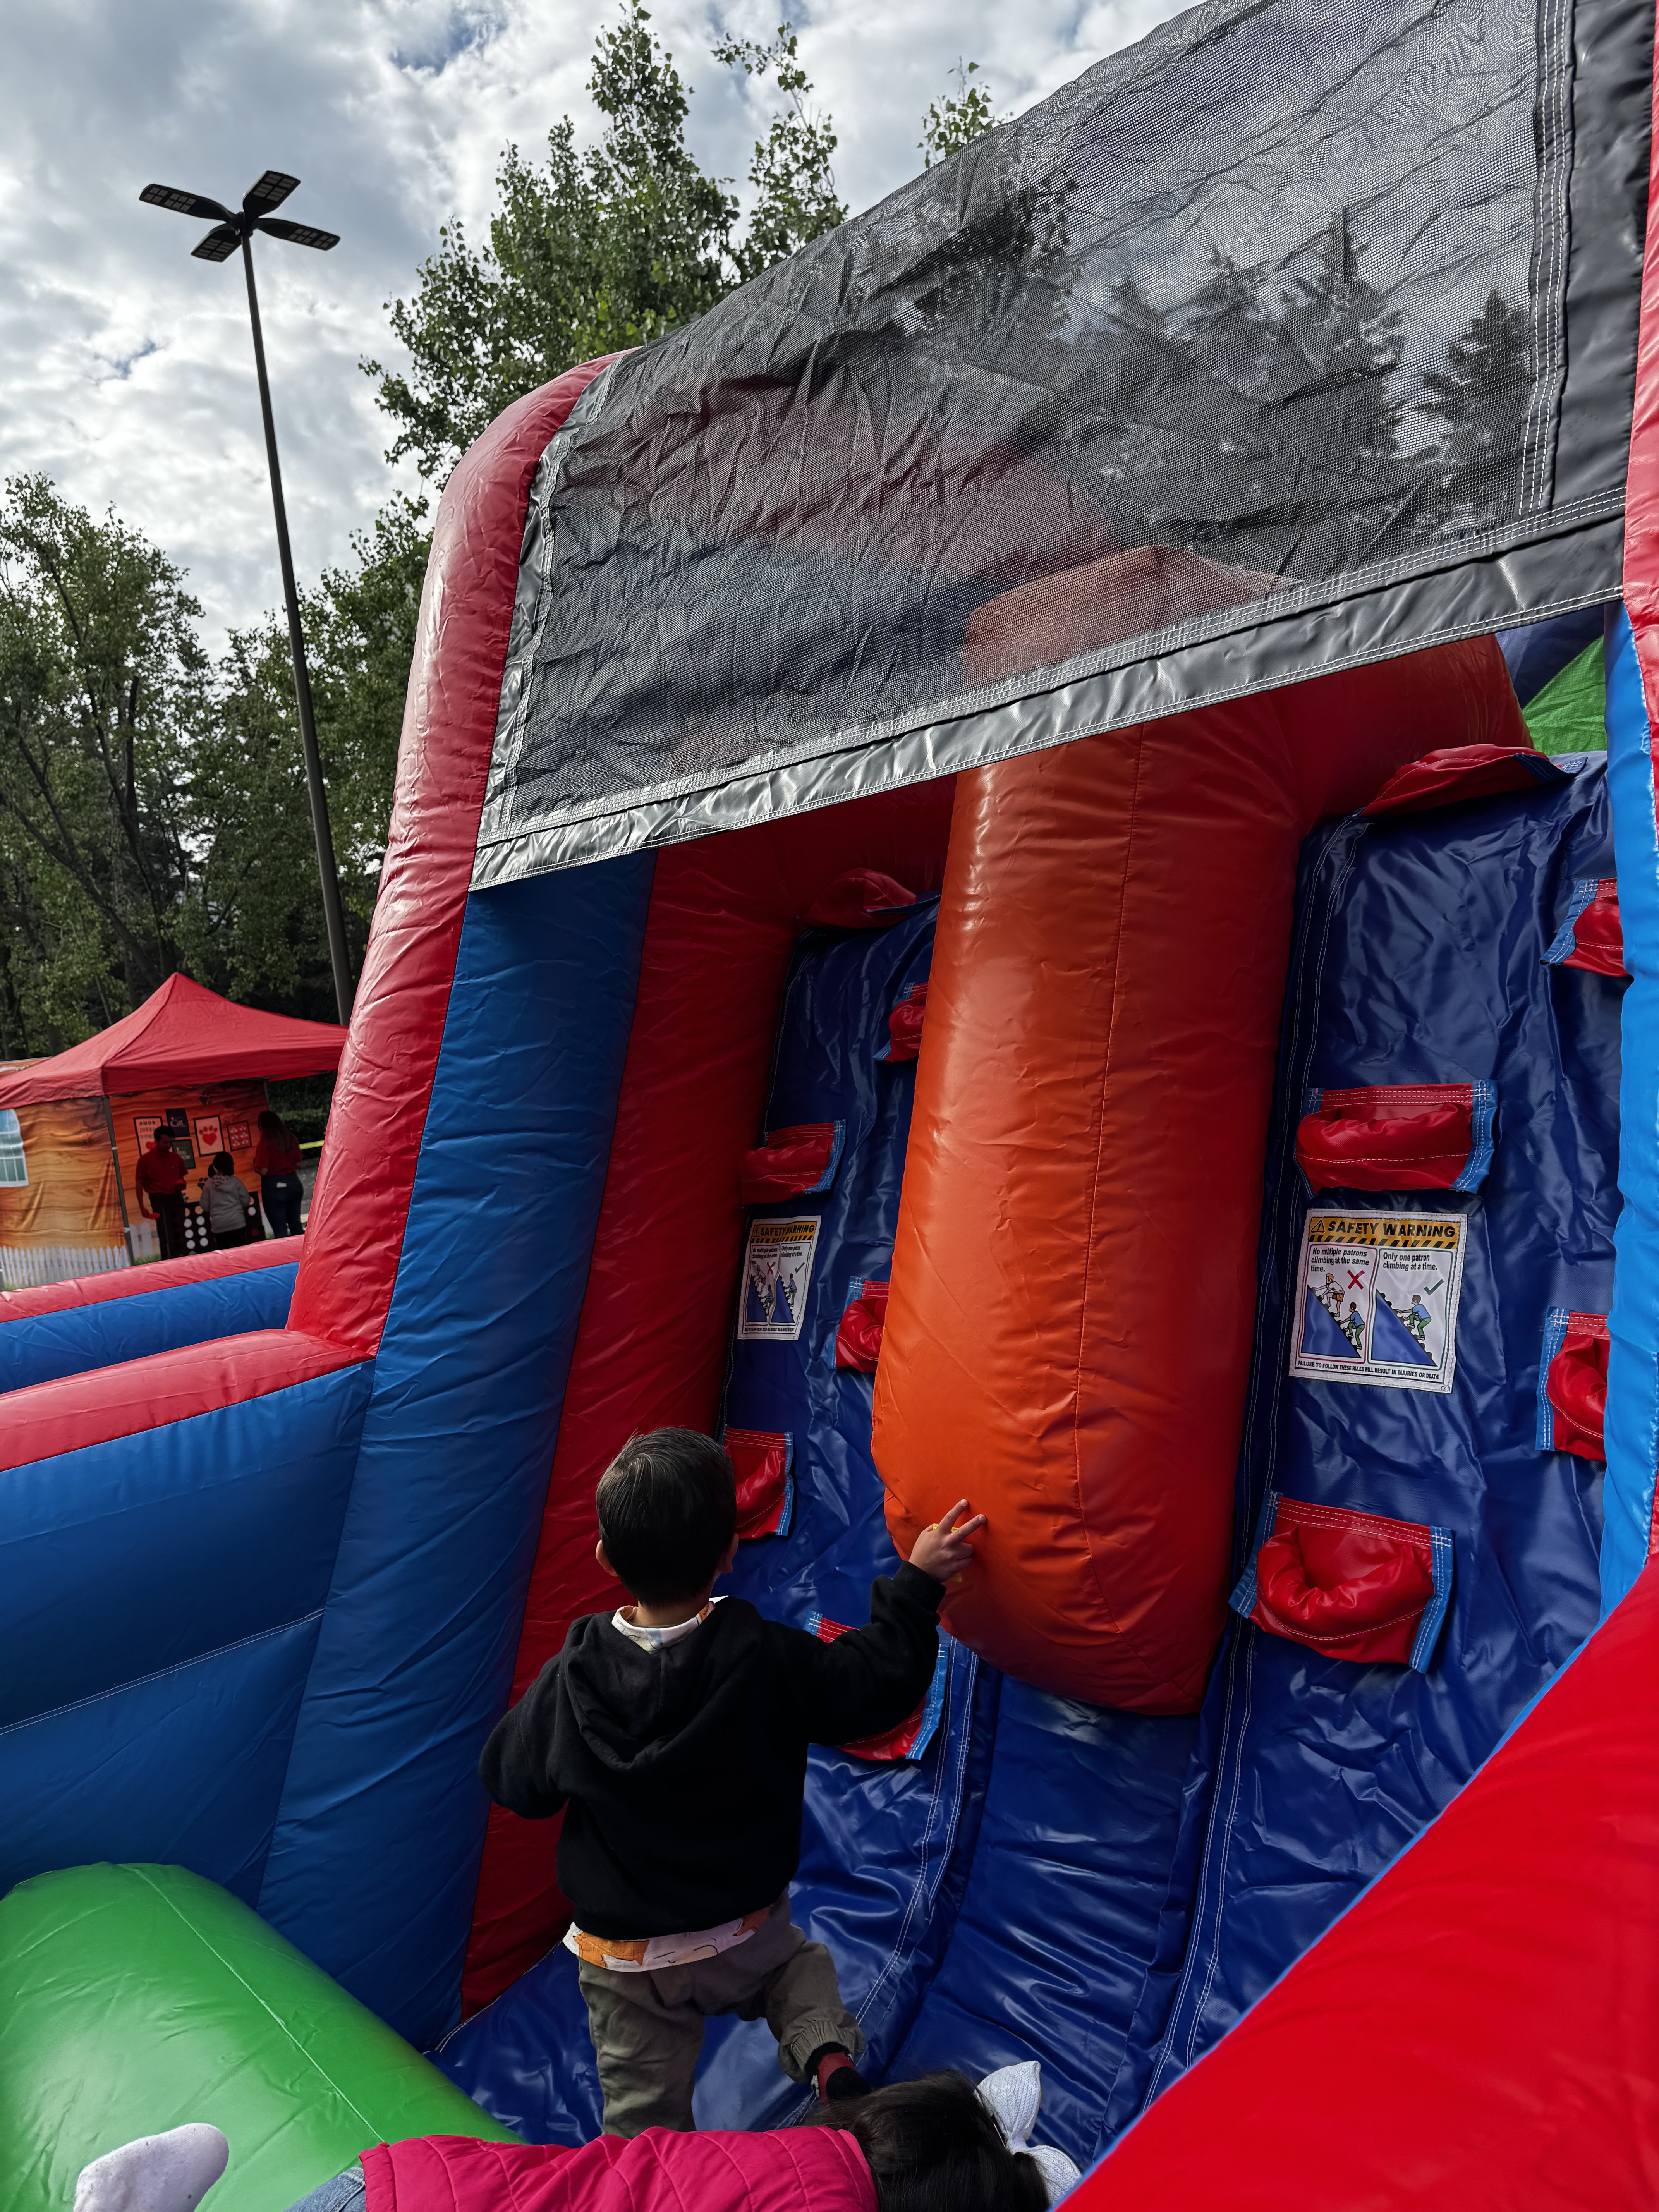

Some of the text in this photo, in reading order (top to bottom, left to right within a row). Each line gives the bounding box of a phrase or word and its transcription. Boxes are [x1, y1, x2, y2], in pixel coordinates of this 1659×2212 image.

[761, 1224, 815, 1236] SAFETY WARNING
[1328, 1221, 1455, 1237] SAFETY WARNING
[1321, 1248, 1341, 1256] multiple
[1383, 1252, 1398, 1262] Only
[1412, 1254, 1430, 1262] patron
[1311, 1256, 1334, 1266] climbing
[1383, 1261, 1409, 1271] climbing
